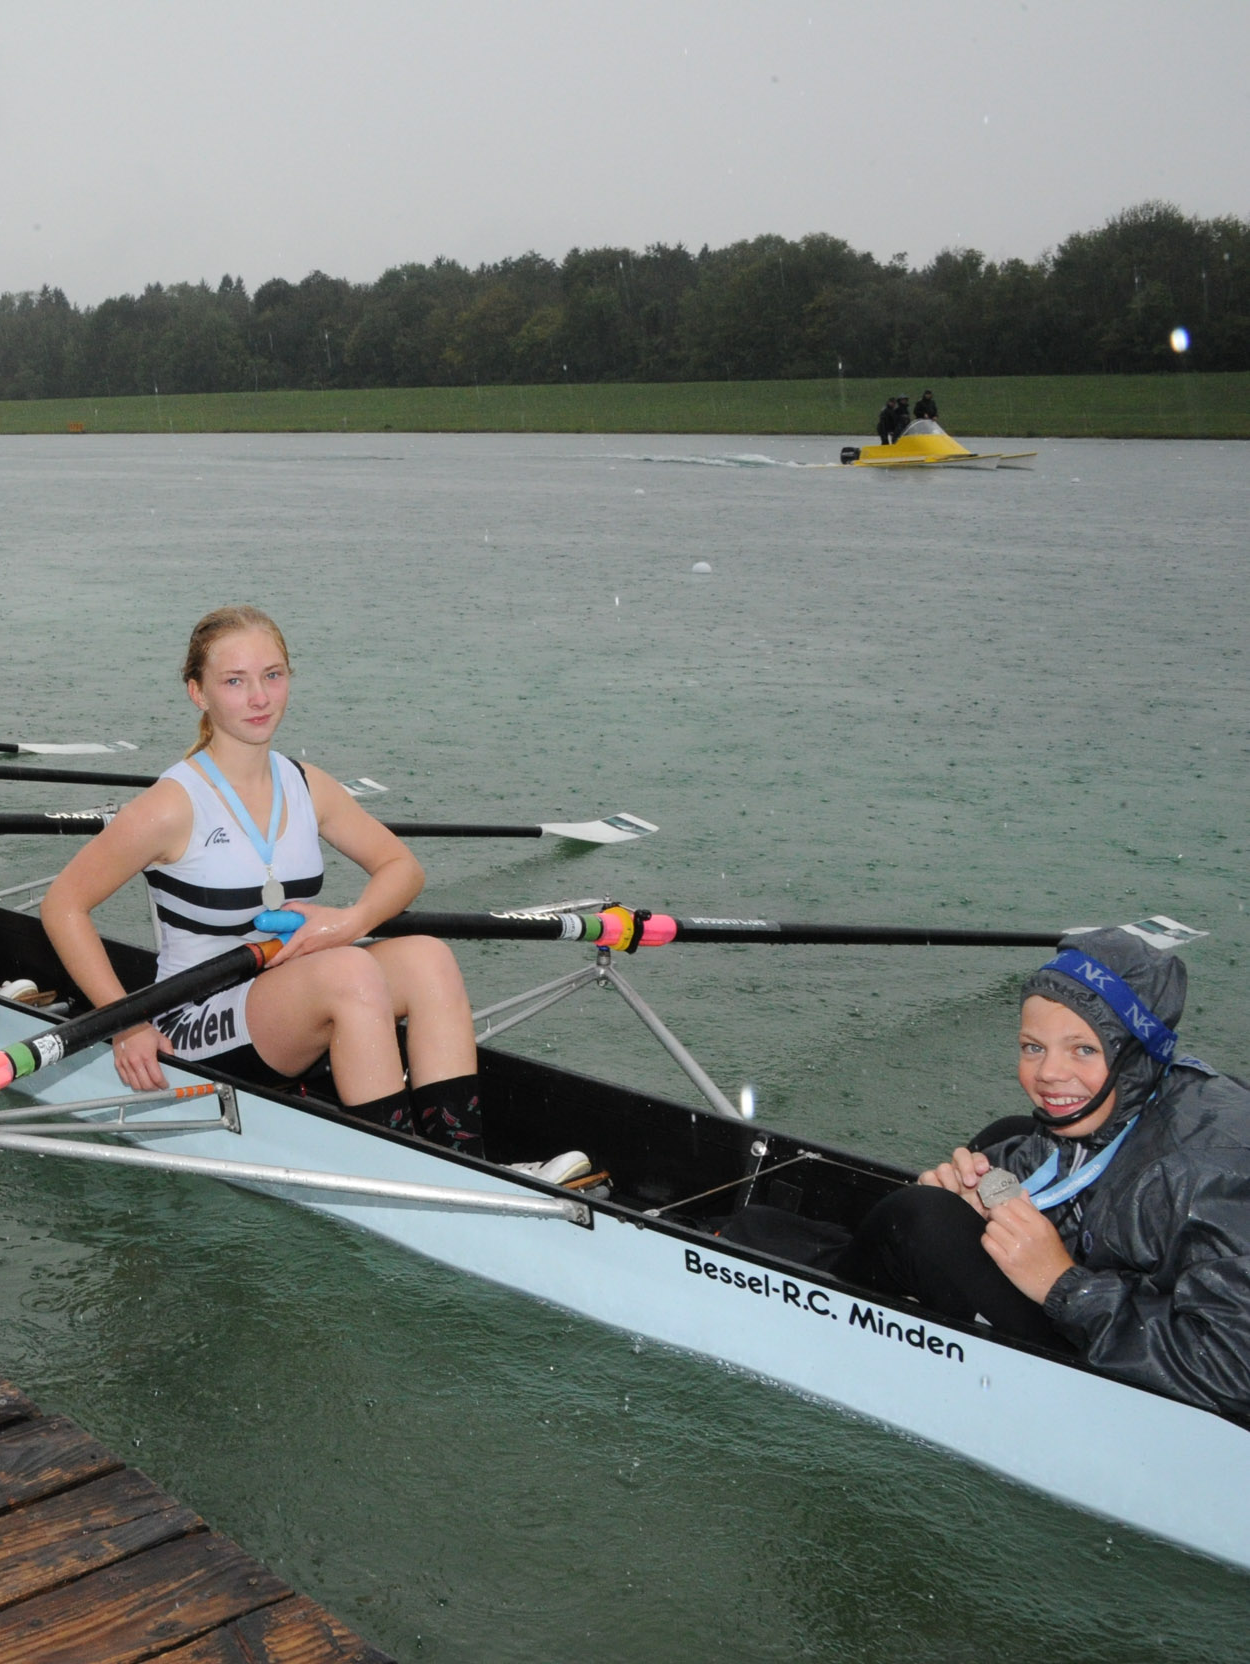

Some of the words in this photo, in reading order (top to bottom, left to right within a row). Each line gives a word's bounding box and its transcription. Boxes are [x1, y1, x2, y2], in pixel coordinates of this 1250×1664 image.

[1075, 961, 1115, 992] NK
[1124, 1003, 1156, 1039] NK
[685, 1248, 838, 1321] Bessel-R.C.
[849, 1302, 964, 1363] Minden
